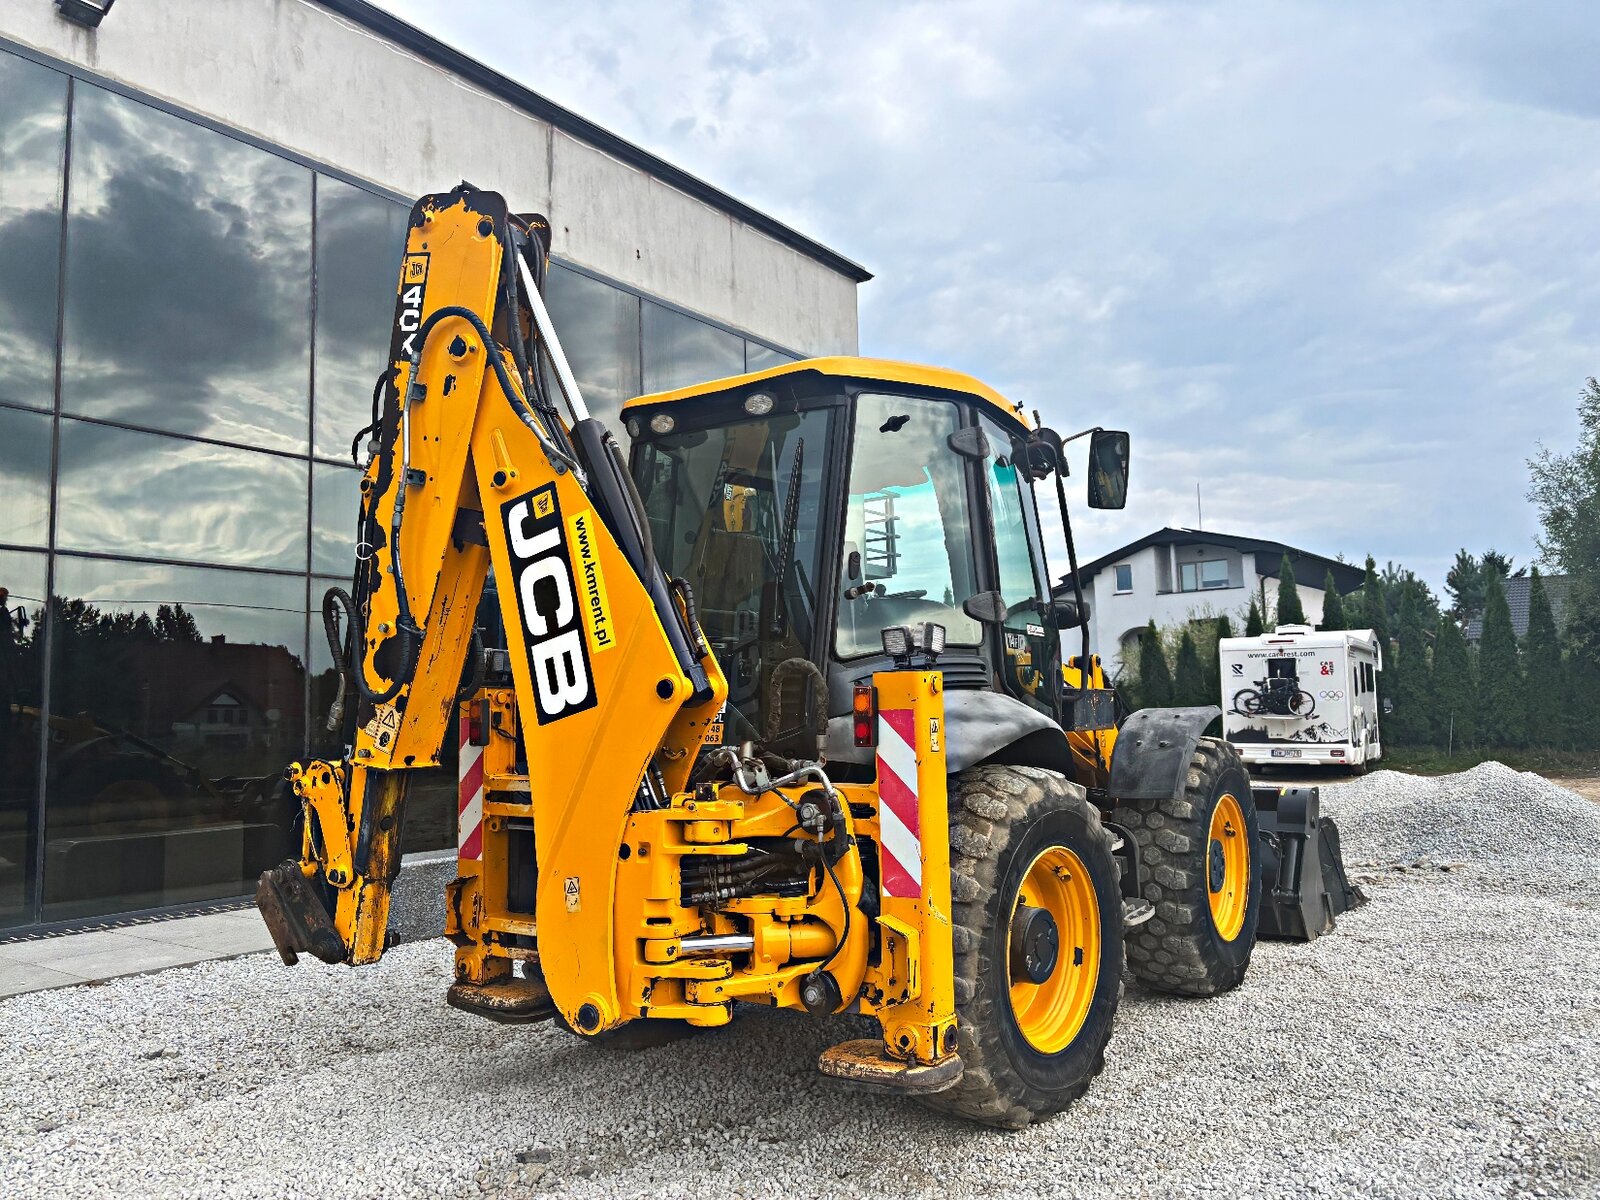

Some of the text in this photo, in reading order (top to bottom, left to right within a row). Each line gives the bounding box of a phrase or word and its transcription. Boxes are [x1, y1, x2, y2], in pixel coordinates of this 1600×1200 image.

[410, 263, 423, 279] JCB
[508, 500, 588, 715] JCB
[574, 516, 611, 647] www.kmrent.pl
